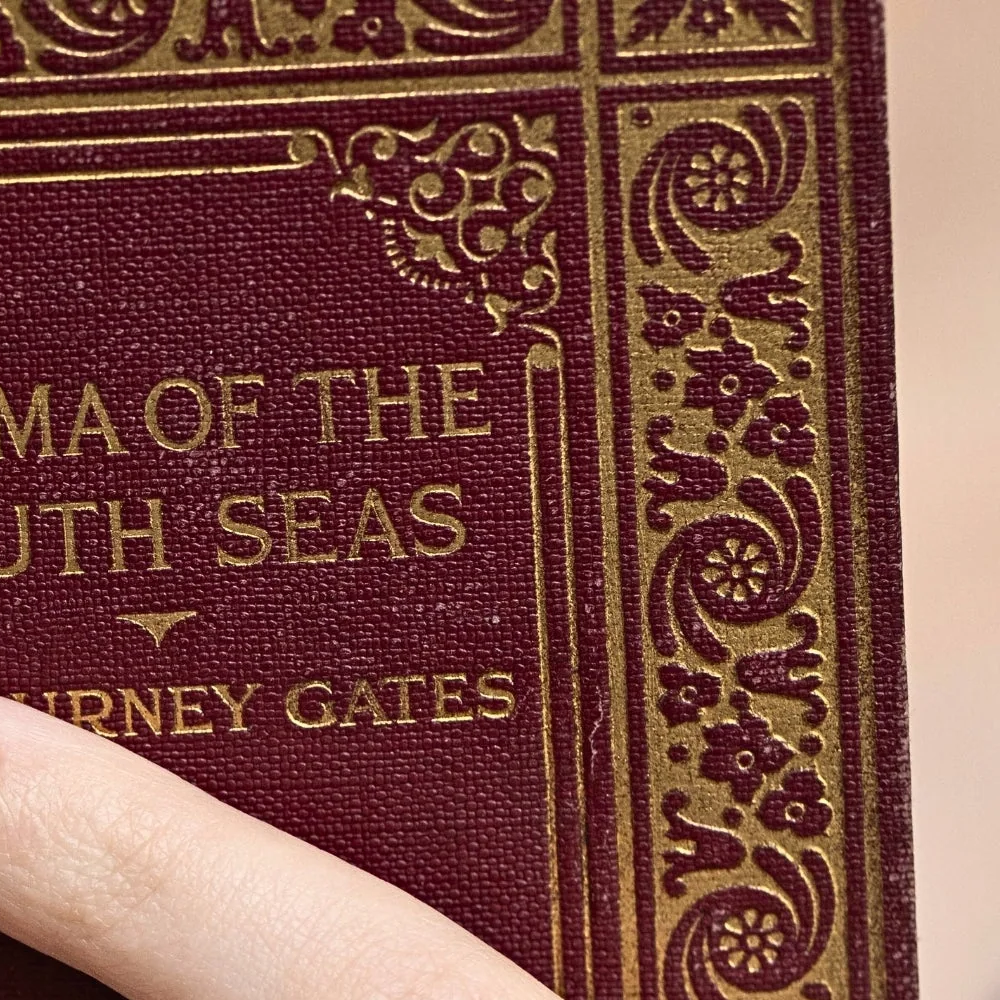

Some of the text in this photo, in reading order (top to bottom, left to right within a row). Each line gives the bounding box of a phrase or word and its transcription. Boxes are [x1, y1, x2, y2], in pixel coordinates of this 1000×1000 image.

[144, 374, 265, 453] OF
[293, 361, 492, 445] THE
[216, 483, 469, 568] SEAS
[285, 672, 516, 730] GATES
